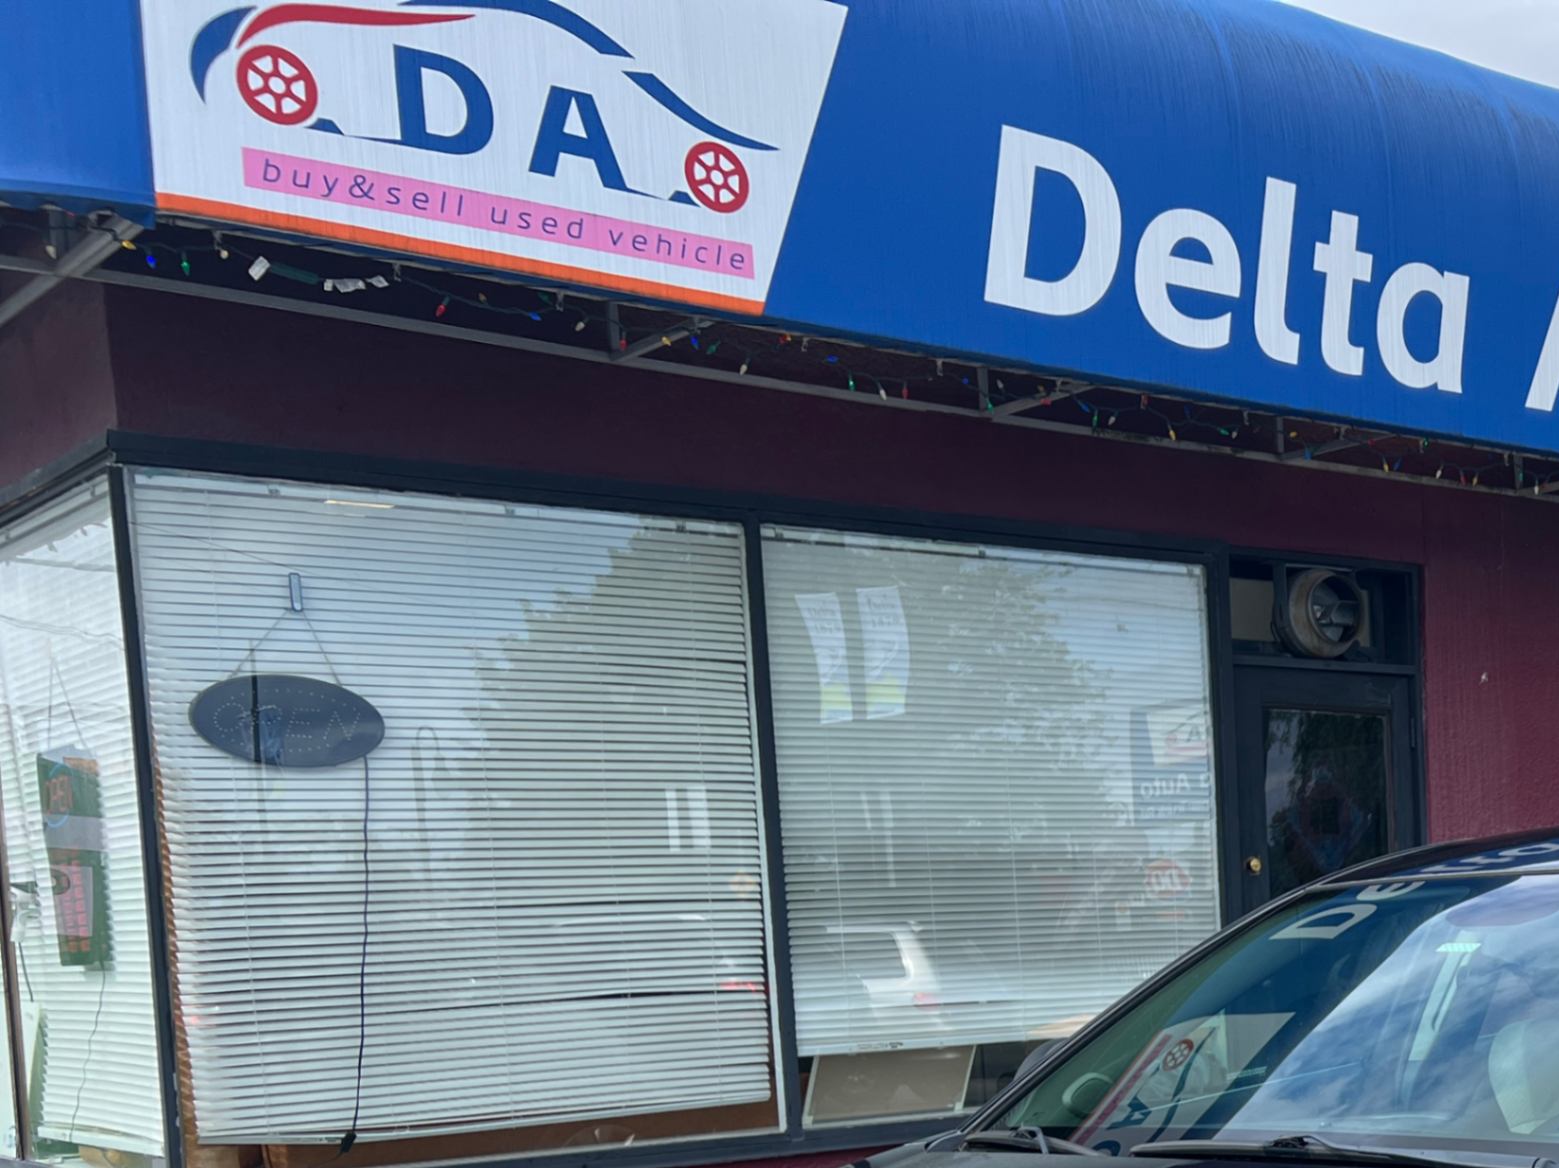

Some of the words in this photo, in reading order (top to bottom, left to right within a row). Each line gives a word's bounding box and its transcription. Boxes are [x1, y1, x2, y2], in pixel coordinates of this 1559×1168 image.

[262, 158, 465, 218] buy&sell
[490, 204, 584, 240] used
[608, 227, 747, 272] vehicle
[984, 124, 1470, 395] Delta
